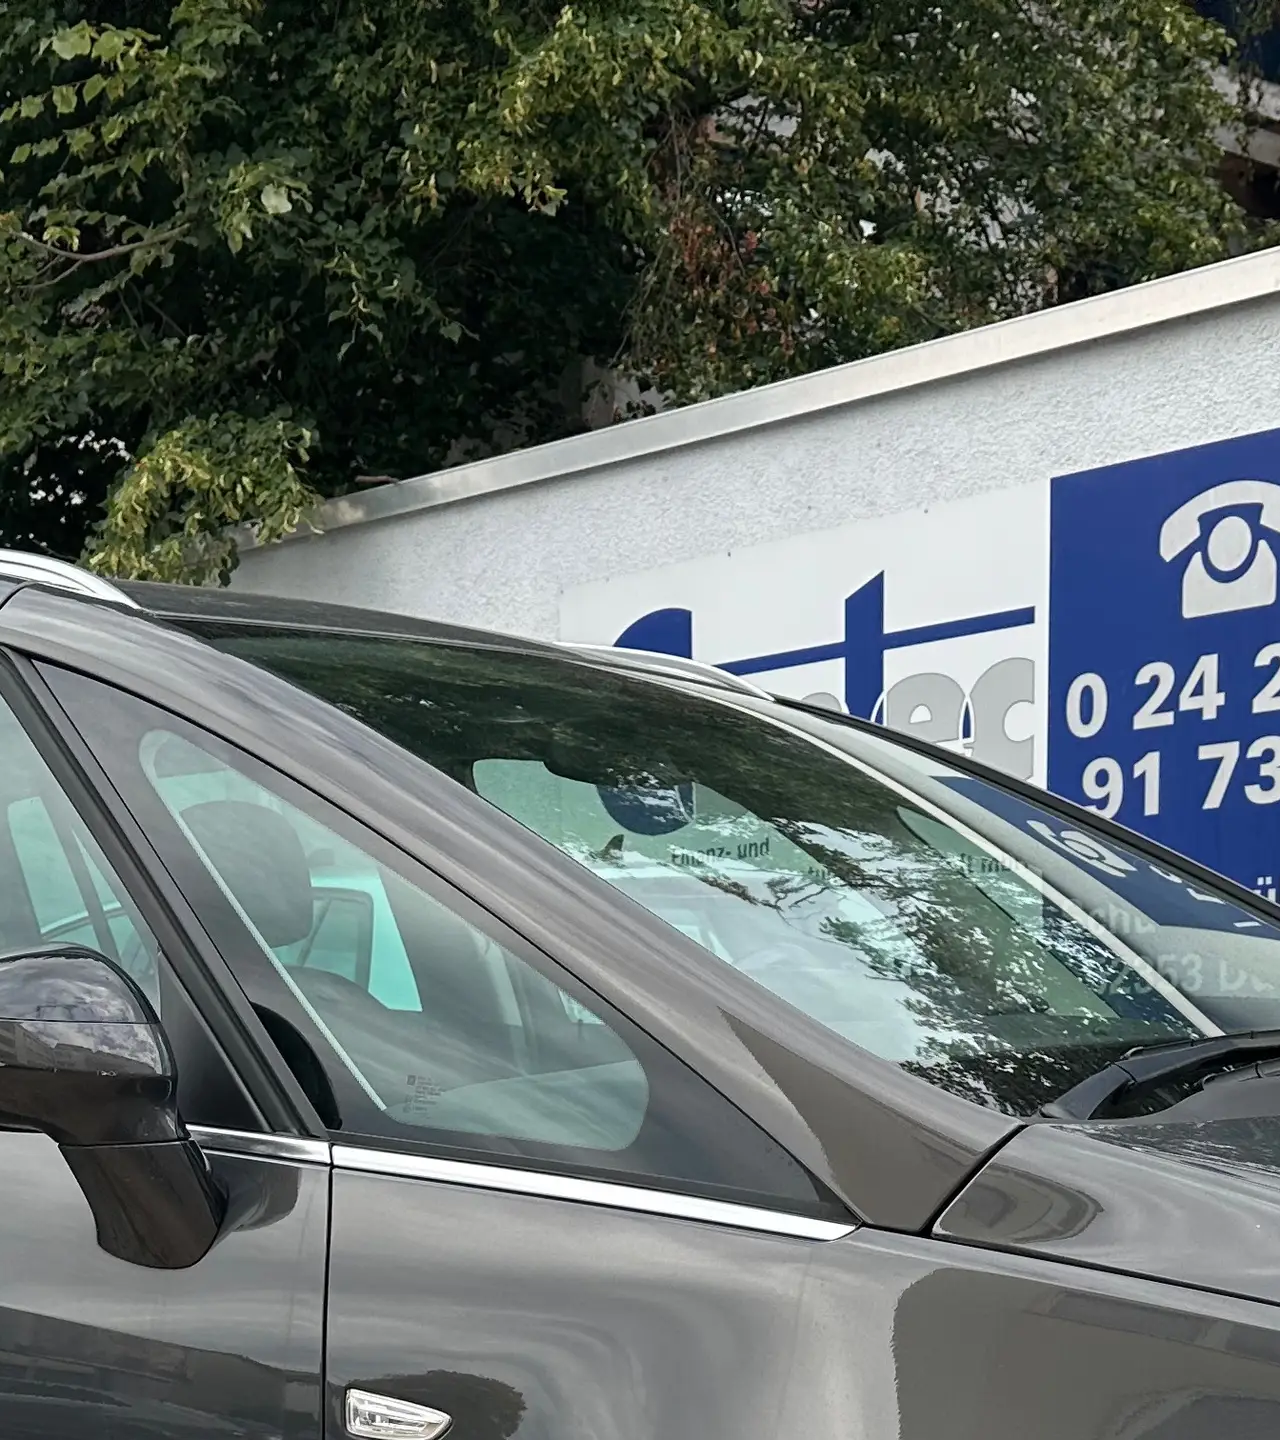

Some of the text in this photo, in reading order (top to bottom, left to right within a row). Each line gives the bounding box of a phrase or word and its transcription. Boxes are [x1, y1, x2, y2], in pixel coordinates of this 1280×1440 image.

[1066, 672, 1109, 738] 0
[1133, 653, 1226, 730] 24
[1082, 751, 1160, 819] 91
